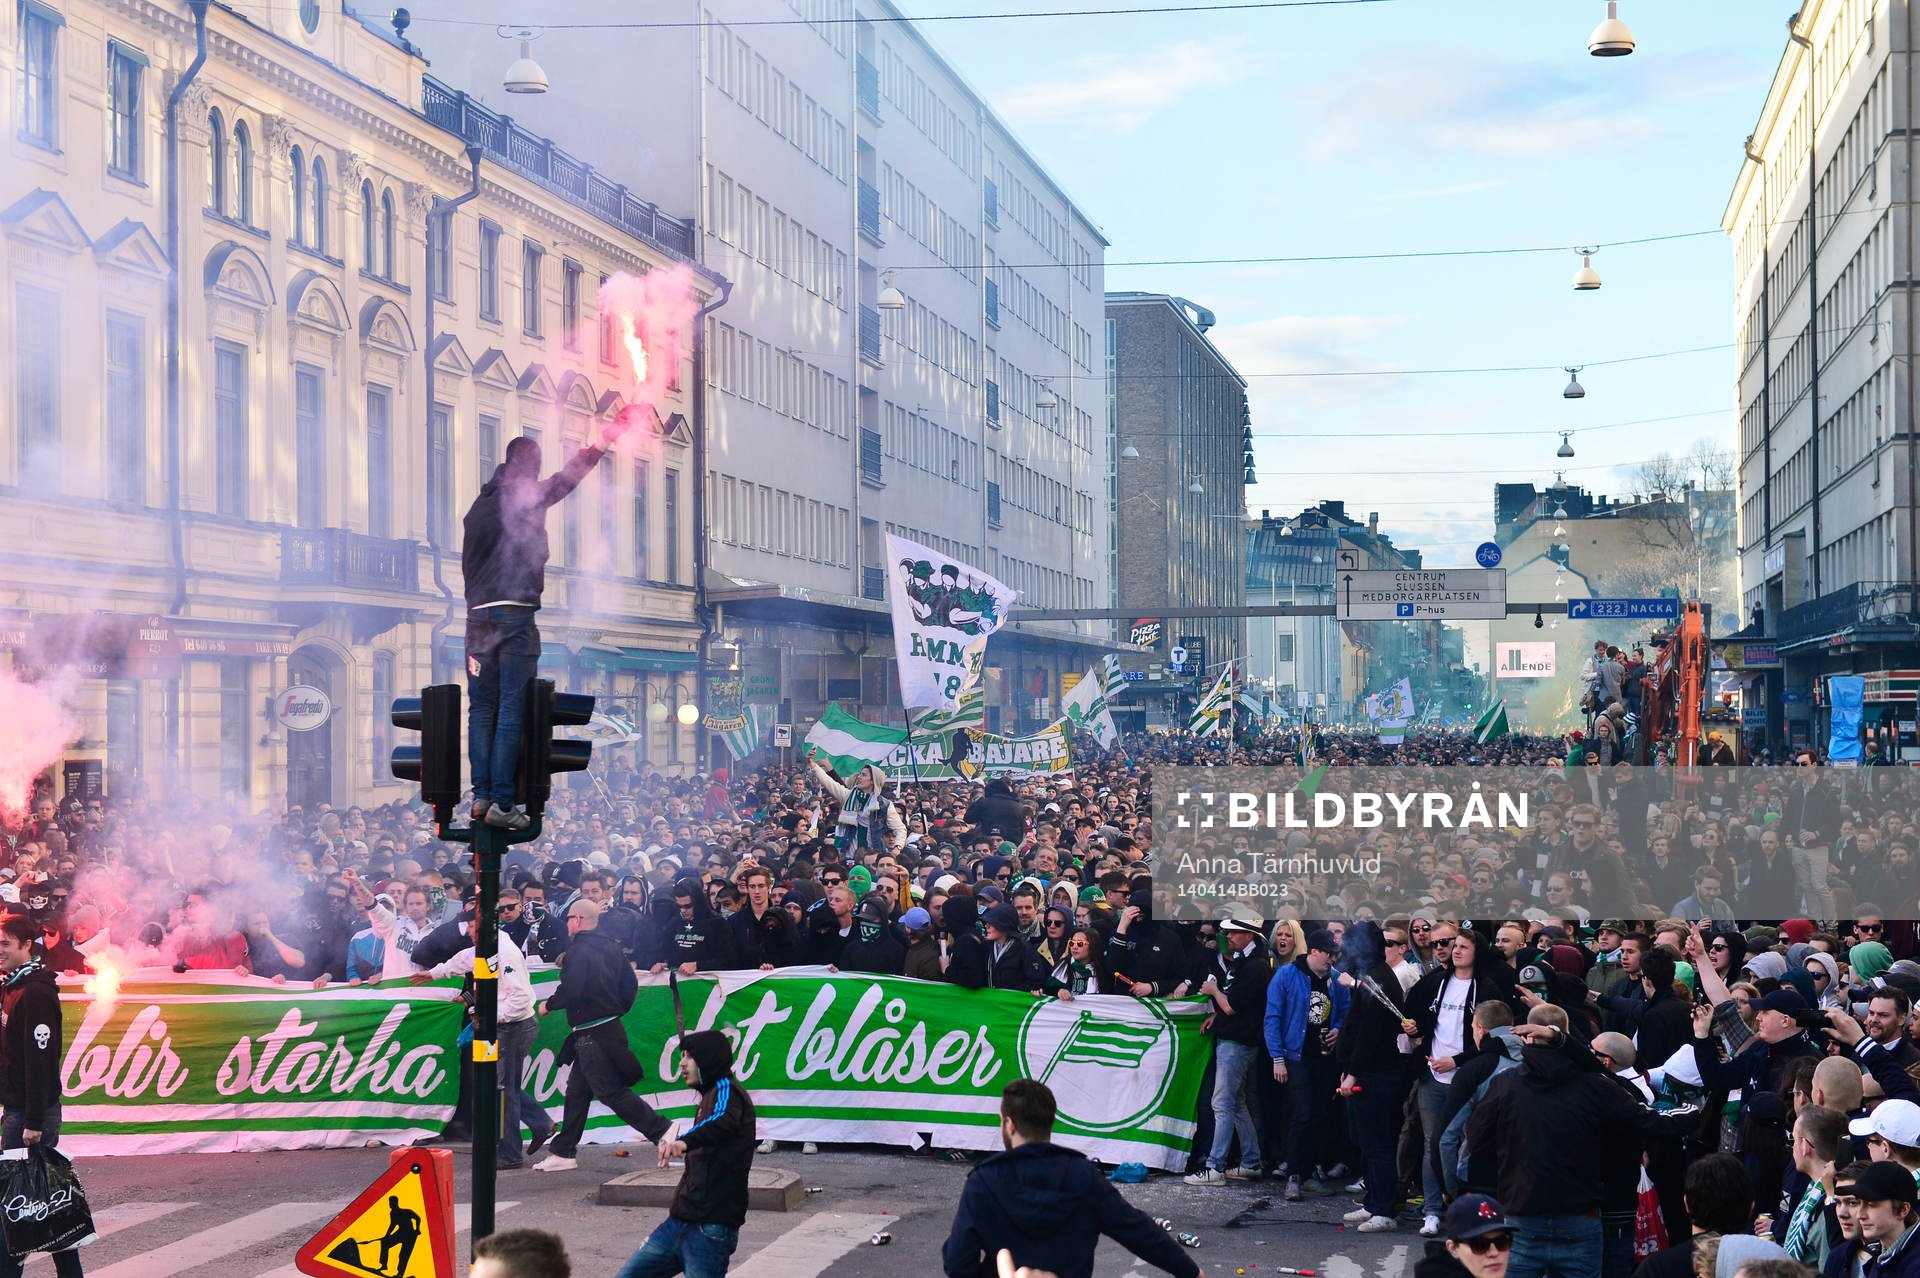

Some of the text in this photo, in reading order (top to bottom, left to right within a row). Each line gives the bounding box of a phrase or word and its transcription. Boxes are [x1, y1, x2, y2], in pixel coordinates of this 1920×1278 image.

[1395, 573, 1446, 582] CENTRUM
[1396, 582, 1446, 592] SLUSSEN
[1361, 592, 1480, 602] MEDBORGARPLATSEN
[1416, 605, 1446, 615] P-hus
[1597, 603, 1673, 614] 222 NACKA
[139, 629, 169, 641] PIERROT
[1131, 623, 1160, 642] Pizza
[1136, 631, 1158, 645] Hut
[280, 695, 324, 717] Segafredo
[968, 735, 1067, 765] BAJARE
[61, 1005, 189, 1098] blir
[216, 1003, 446, 1098] starka
[786, 983, 1003, 1087] blåser
